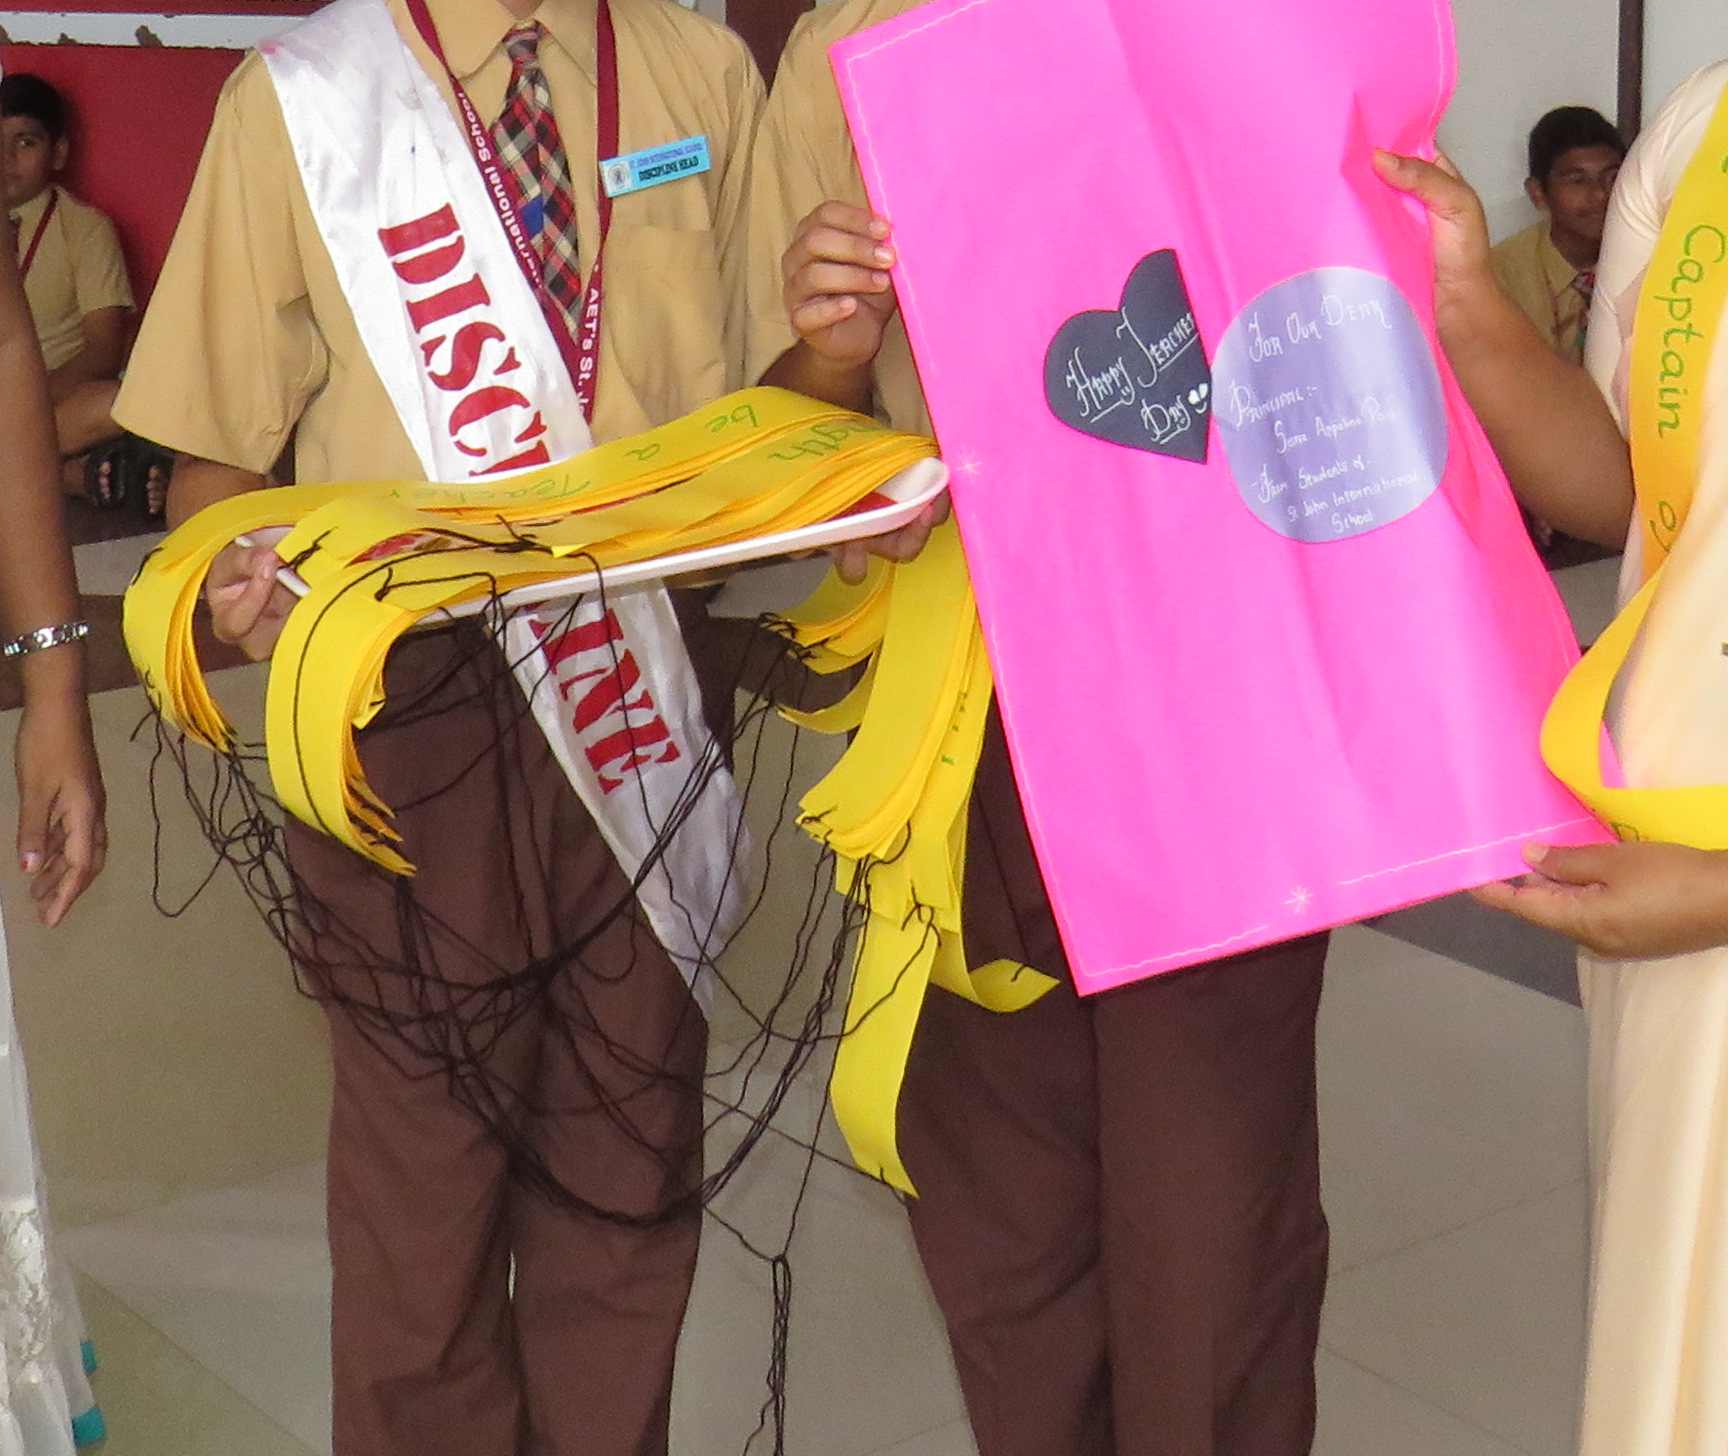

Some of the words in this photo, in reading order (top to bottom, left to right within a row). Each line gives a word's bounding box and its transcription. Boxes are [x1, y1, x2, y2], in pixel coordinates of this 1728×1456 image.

[678, 155, 699, 171] HEAD
[582, 286, 599, 350] AET's
[1653, 224, 1727, 439] Captain
[576, 356, 595, 390] St.
[1298, 461, 1348, 490] Students
[387, 478, 591, 506] Teacher
[1303, 500, 1328, 518] John
[1332, 472, 1420, 506] International
[1332, 508, 1374, 533] School
